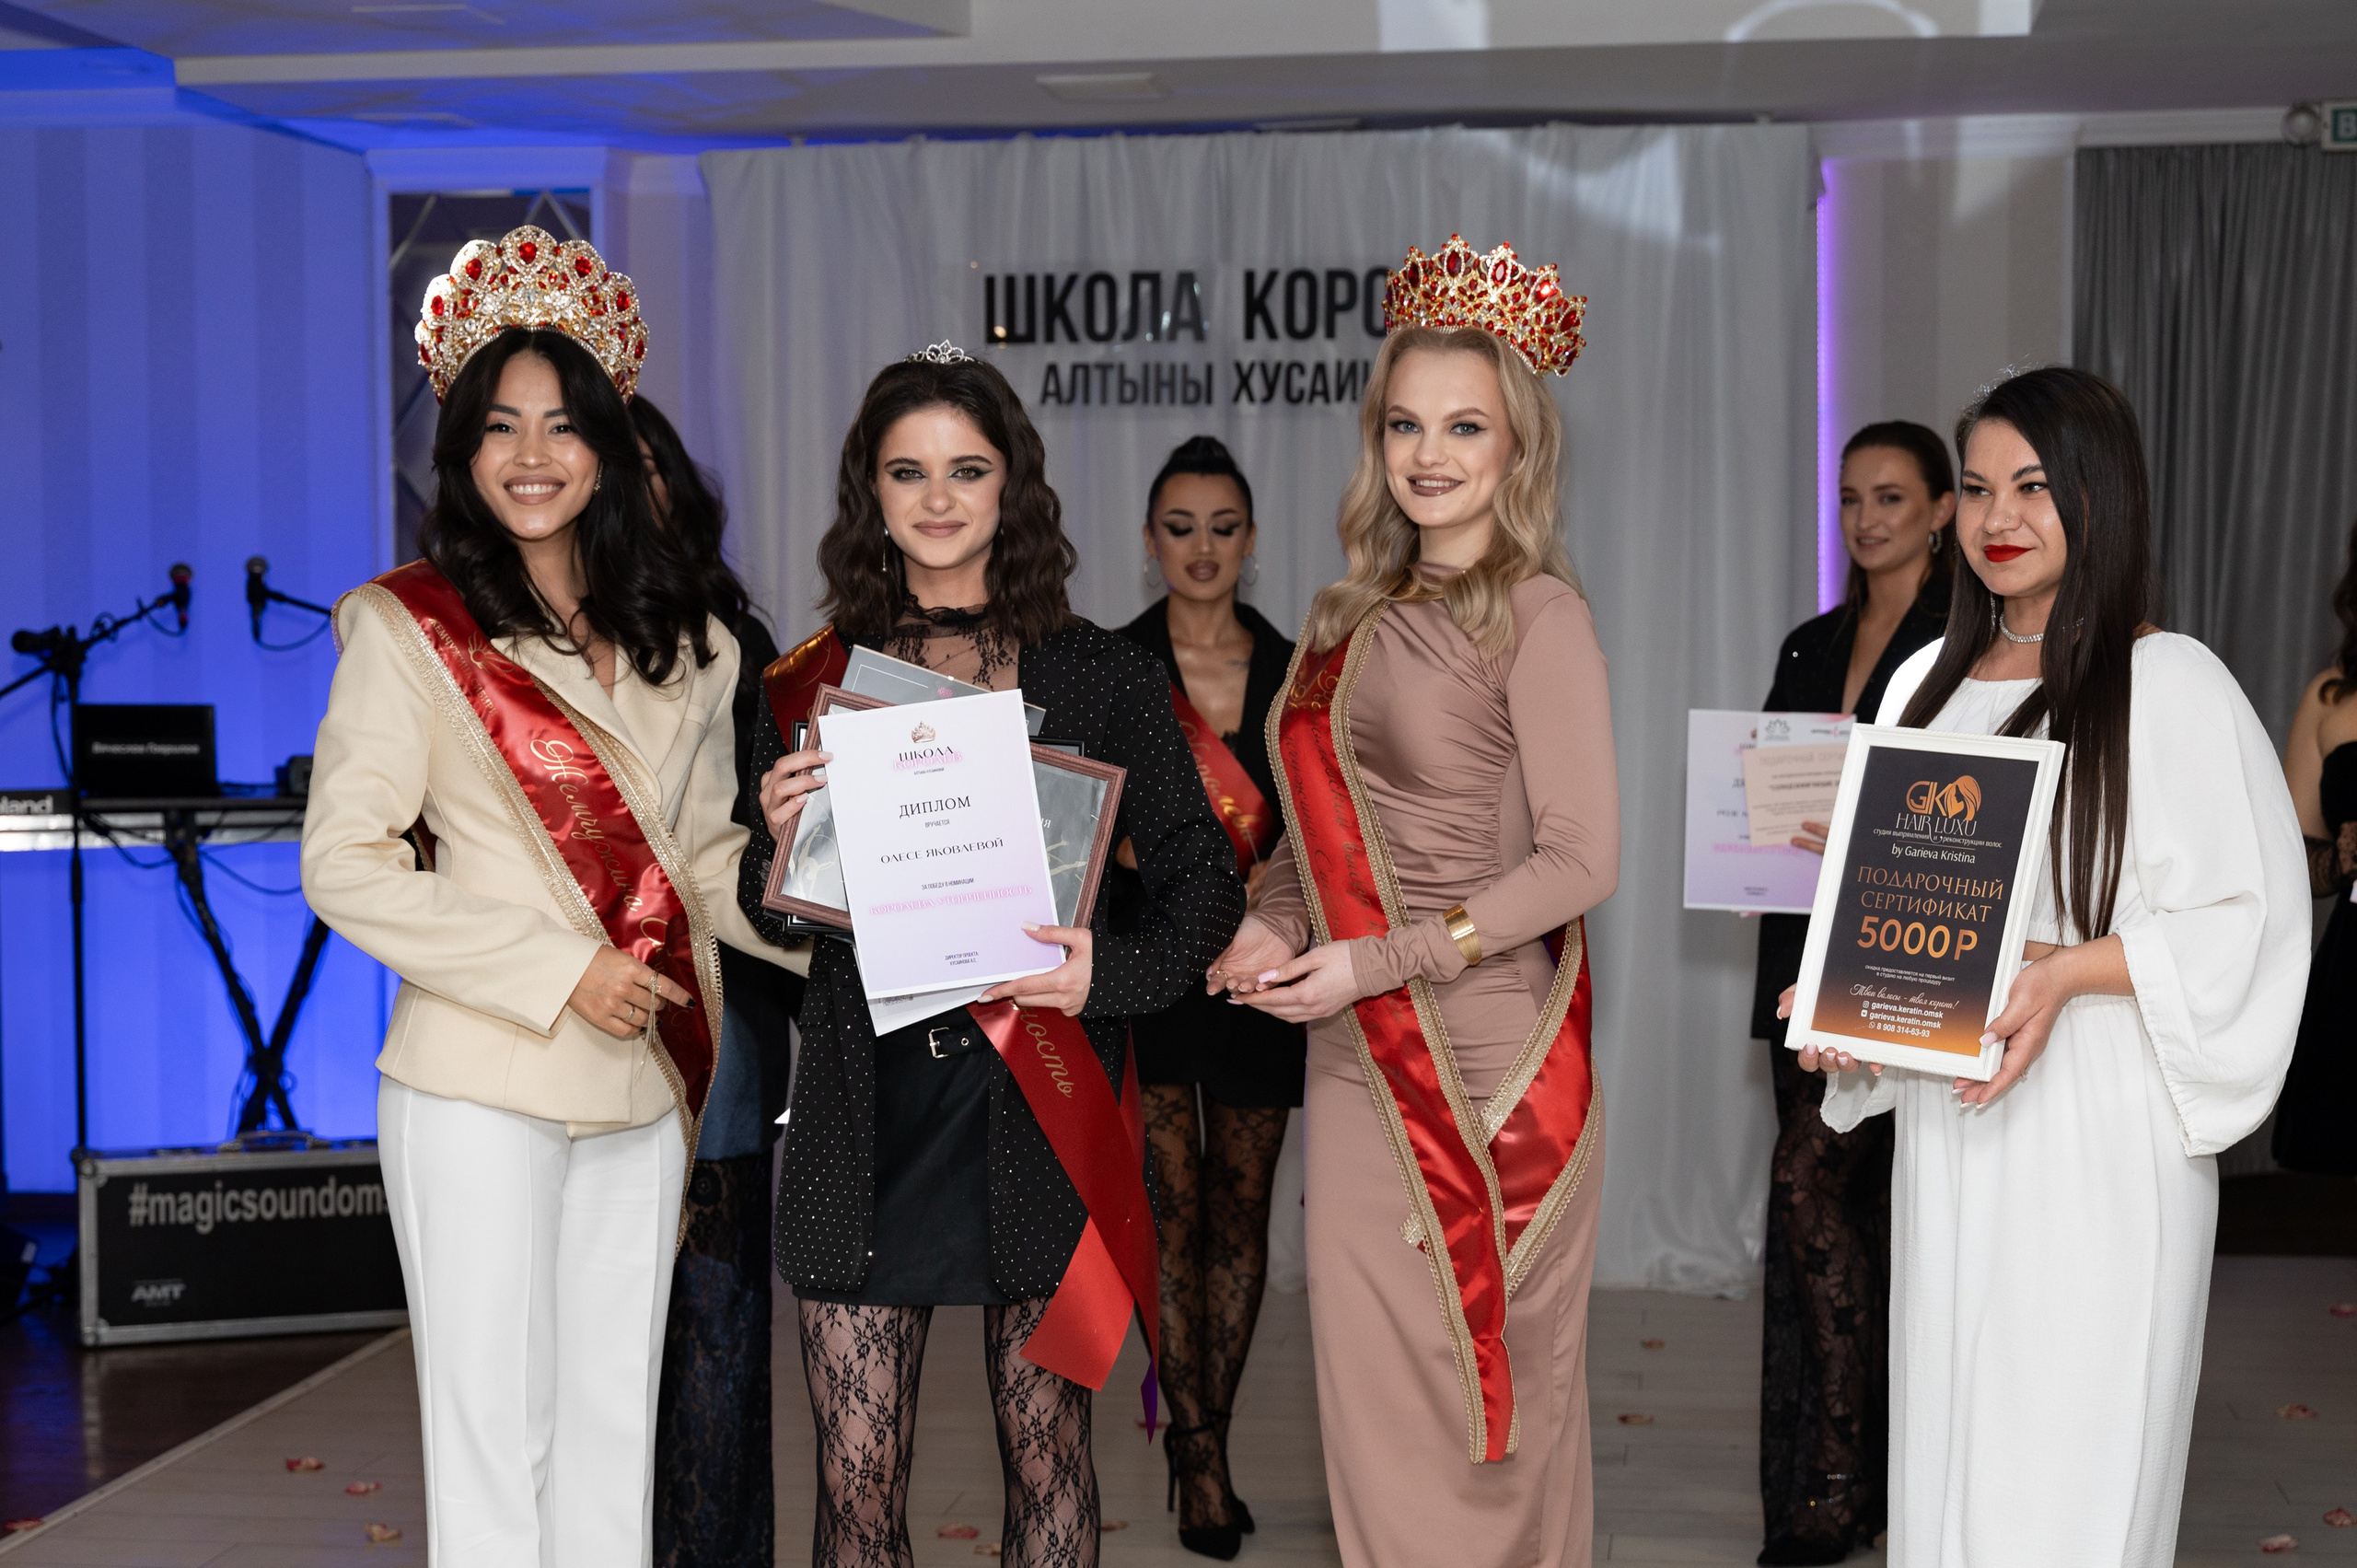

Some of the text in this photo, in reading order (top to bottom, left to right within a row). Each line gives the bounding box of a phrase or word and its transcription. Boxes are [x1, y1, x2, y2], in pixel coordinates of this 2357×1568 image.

[984, 271, 1206, 343] ШКОЛА
[1040, 360, 1213, 406] АЛТЫНЫ
[899, 746, 954, 761] ШКОЛА
[0, 795, 53, 815] land
[899, 796, 971, 819] ДИПЛОМ
[530, 738, 644, 912] Жемчужина
[924, 819, 950, 828] ВРУЧАЕТСЯ
[1896, 813, 1935, 839] HAIR
[1873, 828, 1892, 836] студия
[1943, 836, 1985, 846] реконструкции
[880, 837, 1004, 864] ОЛЕСЕ ЯКОВЛЕВОЙ
[1891, 842, 1976, 864] by Garieva Kristina
[1857, 865, 2004, 900] ПОДАРОЧНЫЙ
[1861, 890, 1992, 923] СЕРТИФИКАТ
[1850, 983, 1875, 997] Твои
[1876, 986, 1901, 1001] волосы
[1909, 992, 1929, 1005] твоя
[1928, 1000, 1960, 1010] корона!
[1869, 1012, 1942, 1028] garieva.keratin.omsk
[1871, 1002, 1944, 1018] garieva.keratin.omsk
[1876, 1022, 1931, 1038] 8 908 314-63-93
